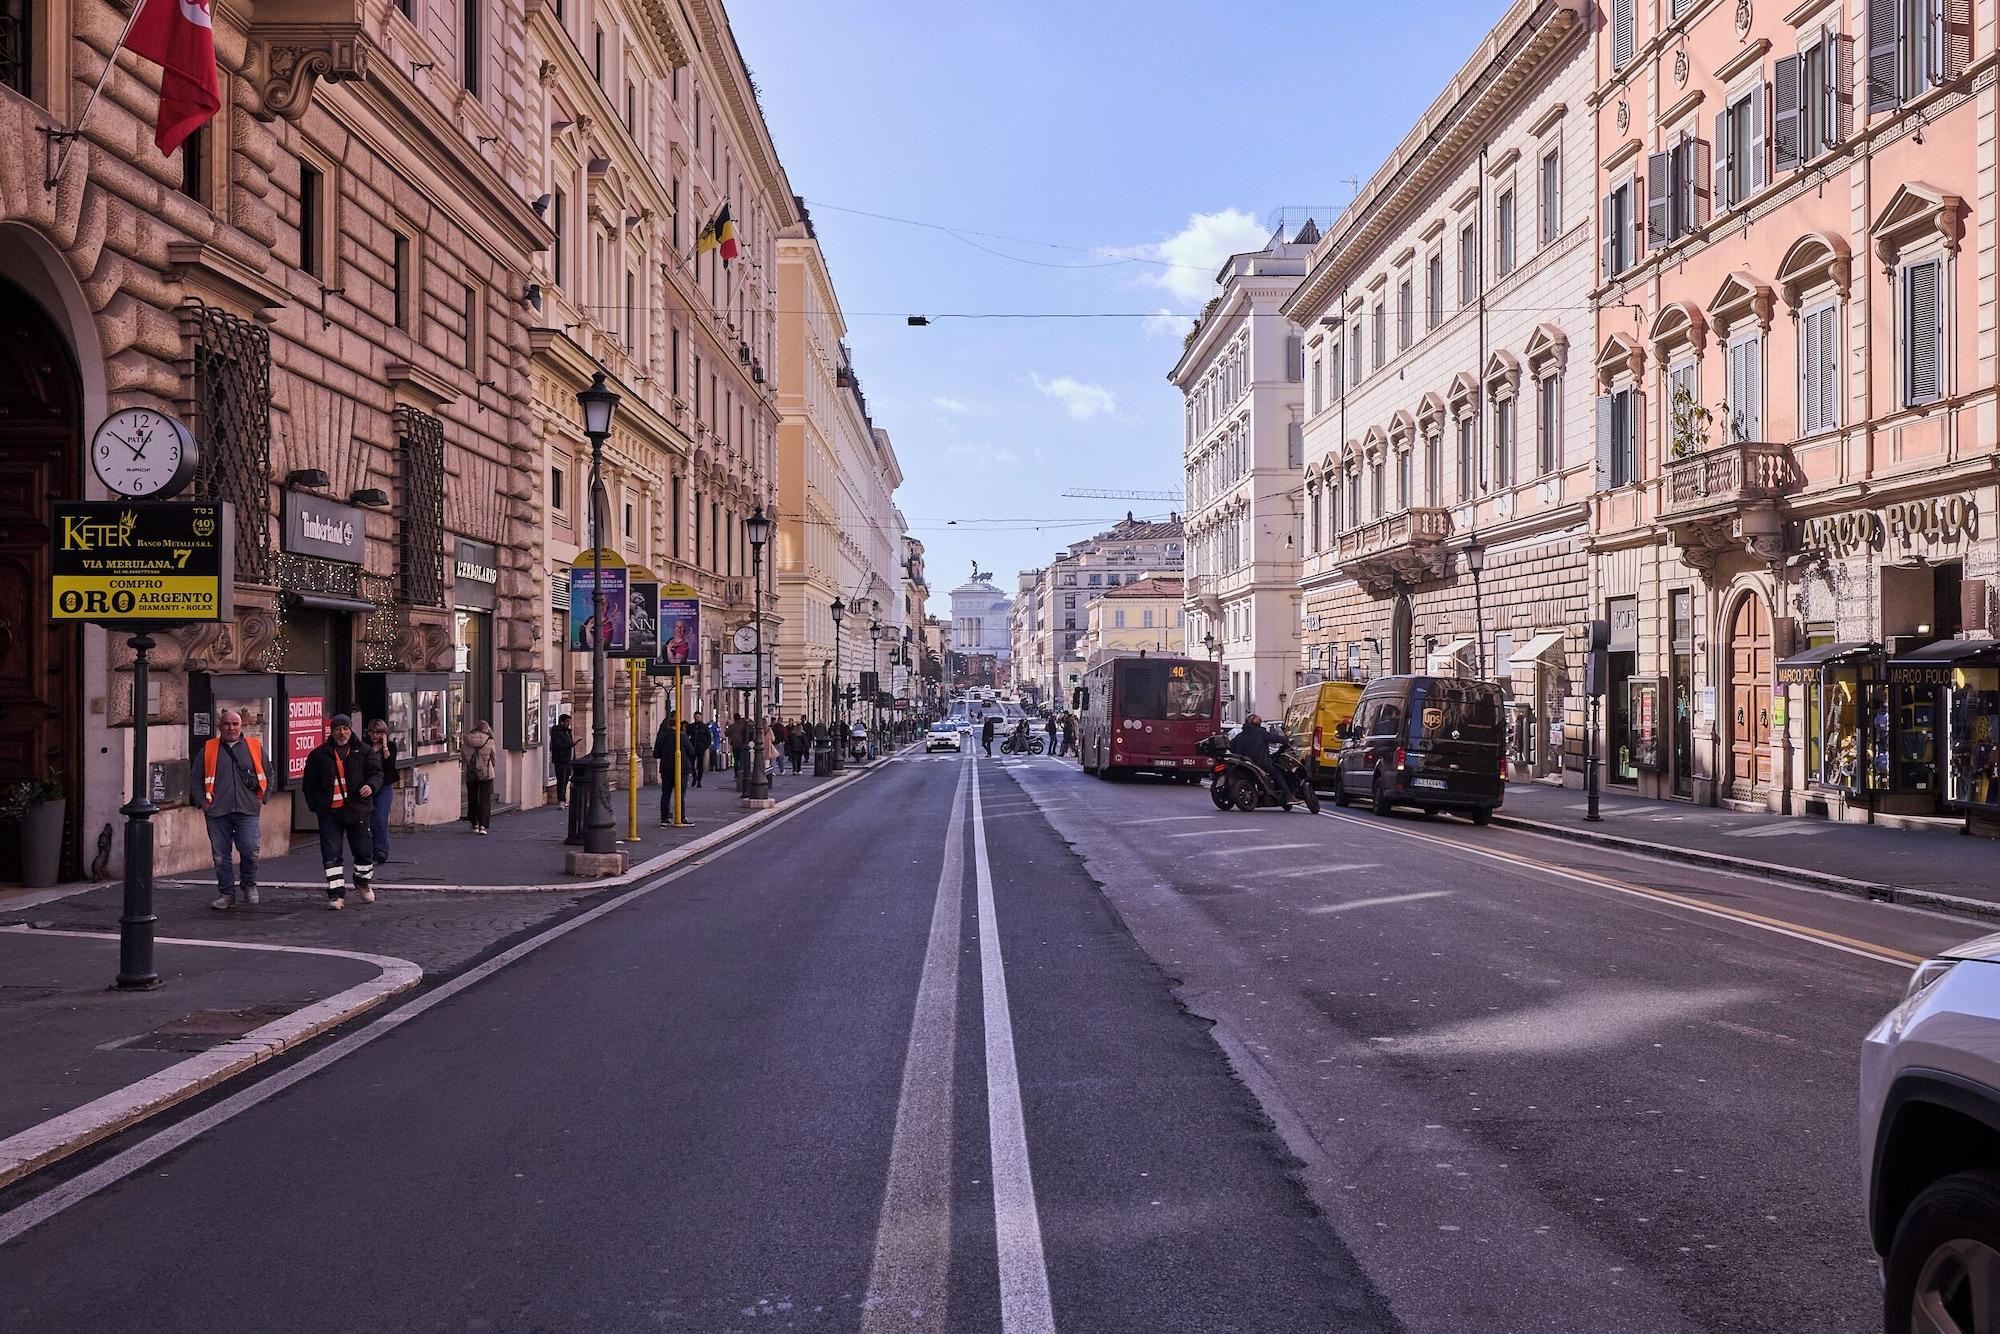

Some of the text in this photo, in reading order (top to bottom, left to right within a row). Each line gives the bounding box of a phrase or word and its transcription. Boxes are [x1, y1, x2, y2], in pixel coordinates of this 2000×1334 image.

[132, 414, 149, 428] 12
[100, 445, 110, 459] 9
[169, 446, 178, 461] 3
[133, 477, 143, 492] 6
[196, 519, 210, 528] 40
[1885, 494, 1964, 539] POLO
[60, 516, 132, 551] KETER
[301, 510, 343, 544] Timberland
[137, 539, 162, 548] BANCO
[82, 549, 192, 570] VIA MERULANA, 7
[456, 561, 497, 585] L'ERBOLARIO
[109, 579, 163, 589] COMPRO
[59, 589, 213, 614] ORO ARGENTO
[1172, 666, 1184, 678] 40
[1778, 668, 1821, 683] MARCO POLO
[1891, 668, 1951, 684] MARCO POLO
[288, 701, 323, 718] SVENDITA
[1424, 713, 1440, 727] ups
[295, 735, 316, 751] STOCK
